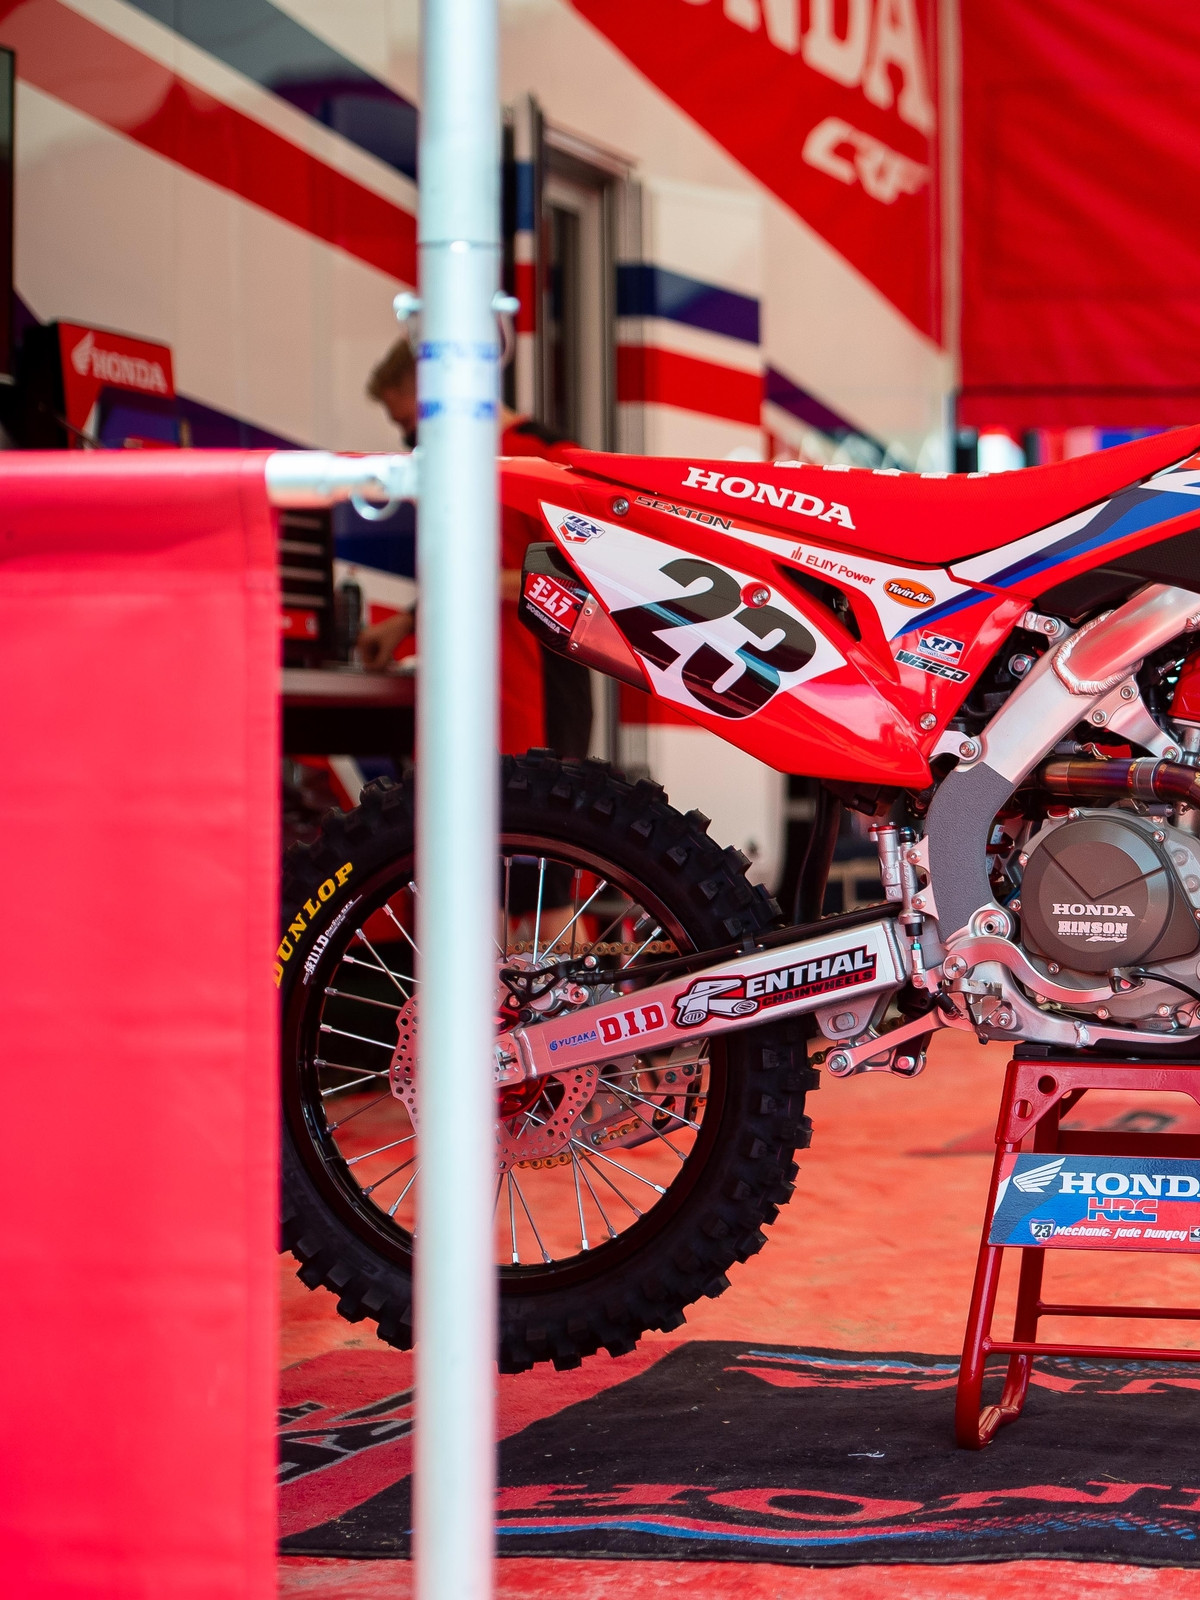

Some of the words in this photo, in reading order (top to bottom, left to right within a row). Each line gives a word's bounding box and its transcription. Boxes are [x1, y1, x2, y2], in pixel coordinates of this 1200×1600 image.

[92, 346, 168, 393] HONDA
[681, 466, 856, 530] HONDA
[634, 496, 733, 531] SEXTON
[838, 566, 876, 585] Power
[888, 582, 912, 599] Twin
[910, 591, 932, 604] Air
[611, 558, 817, 719] 23
[1052, 903, 1135, 917] HONDA
[273, 862, 353, 989] DUNLOP
[1058, 920, 1129, 935] HINSON
[762, 970, 873, 1007] CHAINWHEELS
[558, 1030, 597, 1047] YUTAKA
[599, 1004, 665, 1044] D.I.D
[1088, 1197, 1159, 1222] HRC
[1034, 1225, 1051, 1238] 23
[1054, 1226, 1113, 1238] Mechanic:
[1143, 1228, 1188, 1242] Dungey
